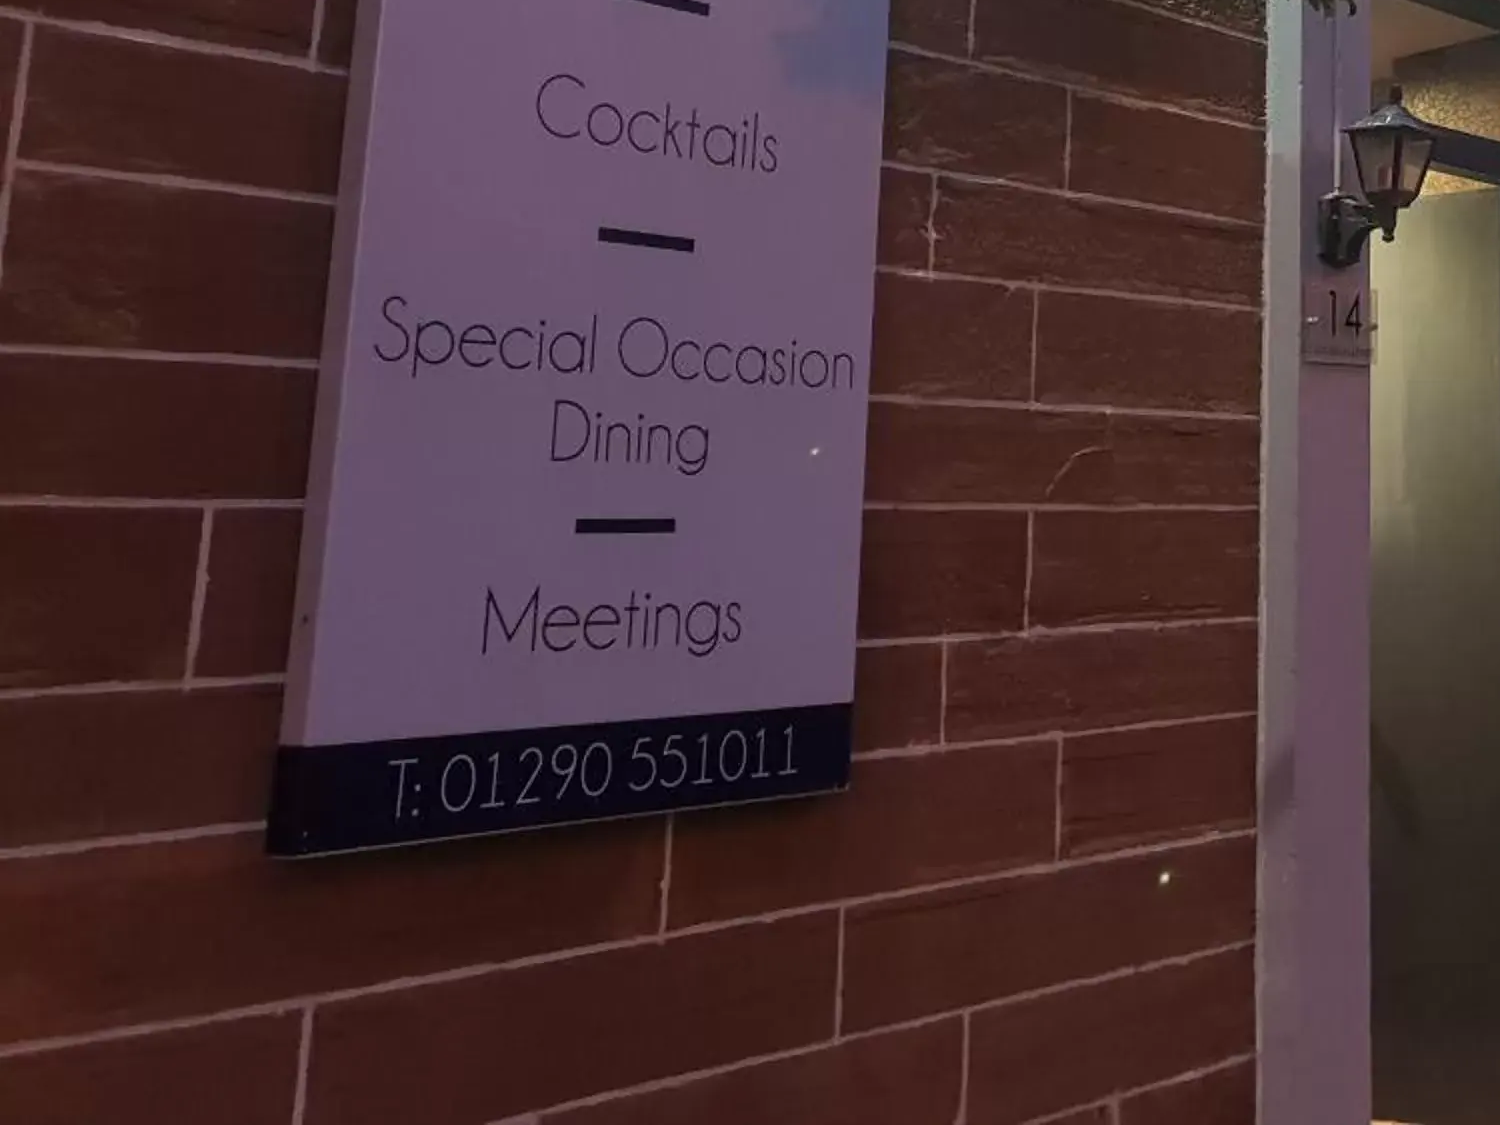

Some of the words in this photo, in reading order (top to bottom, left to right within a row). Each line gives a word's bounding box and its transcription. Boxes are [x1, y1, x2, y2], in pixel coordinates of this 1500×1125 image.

[535, 74, 779, 174] Cocktails
[374, 296, 597, 378] Special
[617, 317, 855, 389] Occasion
[1328, 289, 1363, 338] 14
[550, 399, 709, 475] Dining
[482, 586, 742, 657] Meetings
[390, 759, 421, 819] T:
[440, 738, 614, 813] 01290
[629, 726, 799, 792] 551011
